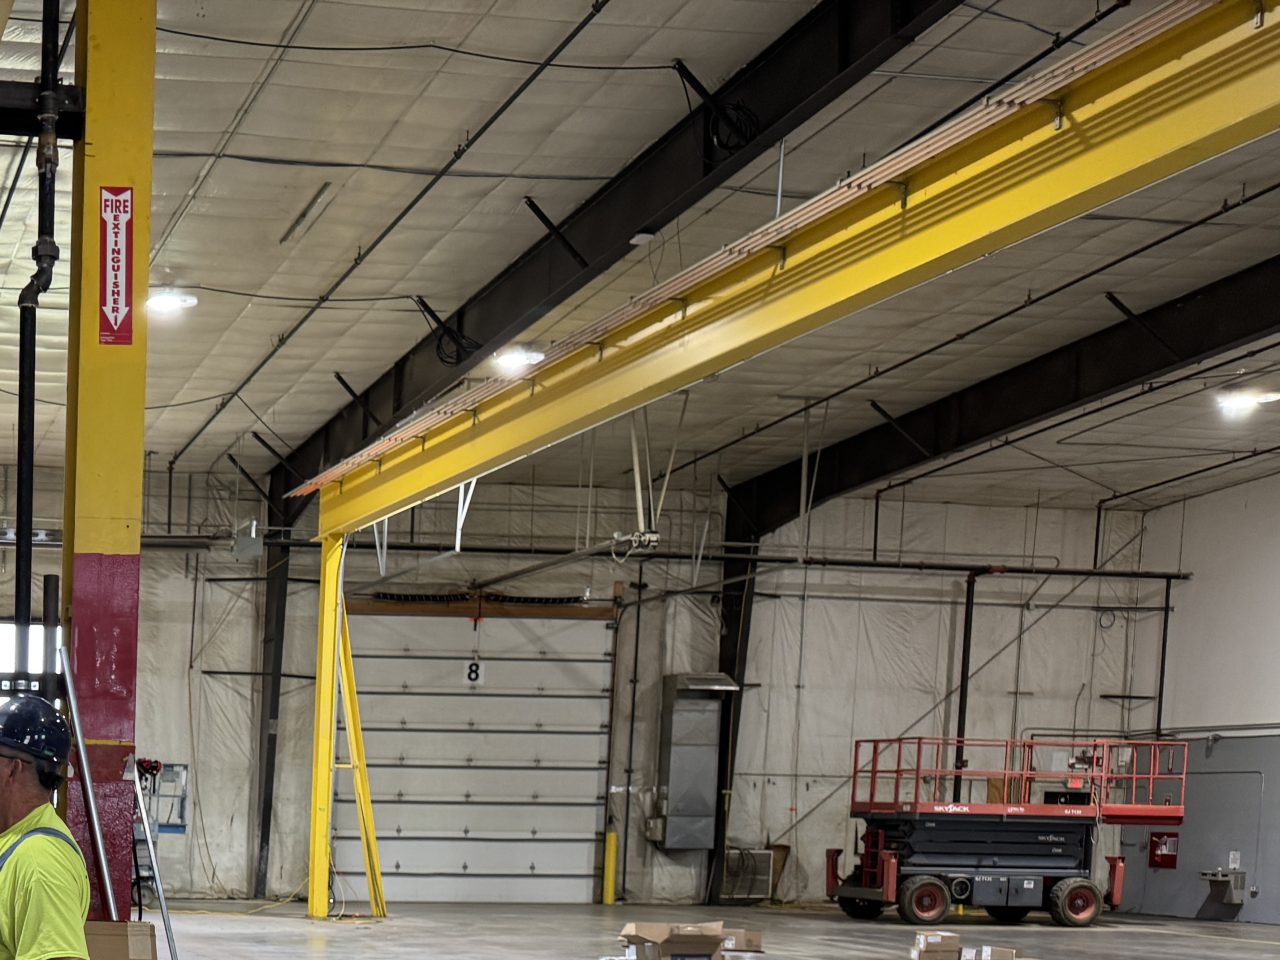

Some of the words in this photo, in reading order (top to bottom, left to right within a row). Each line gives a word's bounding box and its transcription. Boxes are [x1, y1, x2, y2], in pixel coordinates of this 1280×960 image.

[103, 199, 129, 213] FIRE
[111, 214, 121, 314] EXTINGUISHER
[468, 663, 480, 681] 8
[933, 804, 970, 813] SKYJACK
